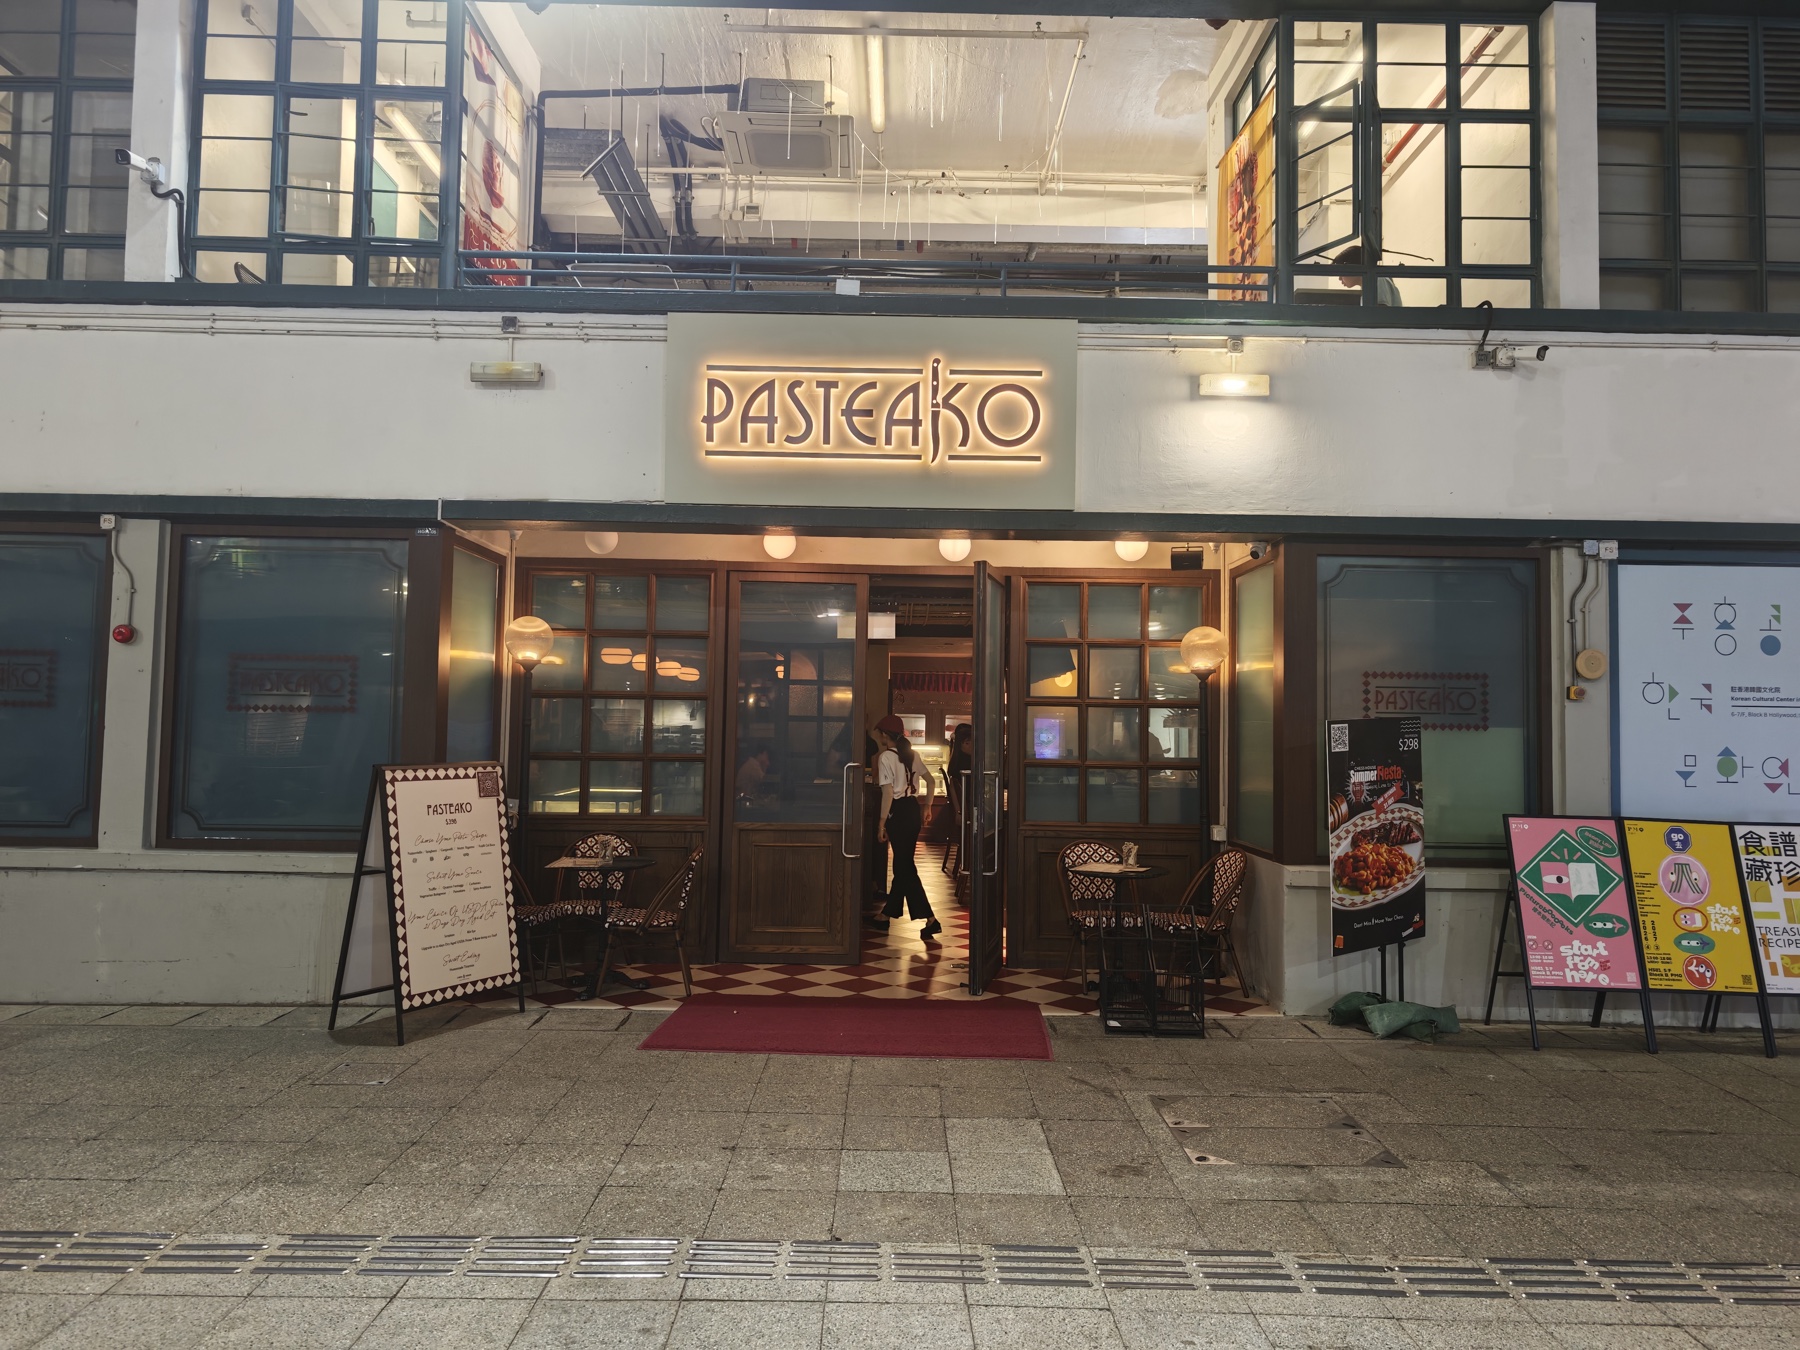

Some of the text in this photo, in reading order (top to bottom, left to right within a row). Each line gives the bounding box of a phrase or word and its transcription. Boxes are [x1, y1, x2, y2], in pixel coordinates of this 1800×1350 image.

[701, 358, 1041, 464] PASTEAKO
[1374, 683, 1476, 715] PASTEAKO
[1398, 738, 1419, 751] $298
[1350, 765, 1402, 782] Summer Fiesta
[426, 802, 473, 815] PASTEAKO
[436, 832, 452, 844] Your
[1671, 833, 1684, 841] go
[1739, 830, 1797, 857] 食譜
[426, 871, 447, 883] Select
[447, 869, 463, 880] Your
[1744, 858, 1800, 886] 藏珍
[408, 911, 425, 924] Your
[427, 908, 447, 920] Choice
[462, 900, 488, 914] USDA
[1707, 903, 1739, 915] start
[1560, 940, 1608, 957] start
[1759, 938, 1800, 949] RECIPE
[461, 951, 481, 963] Ending
[1566, 955, 1599, 970] from
